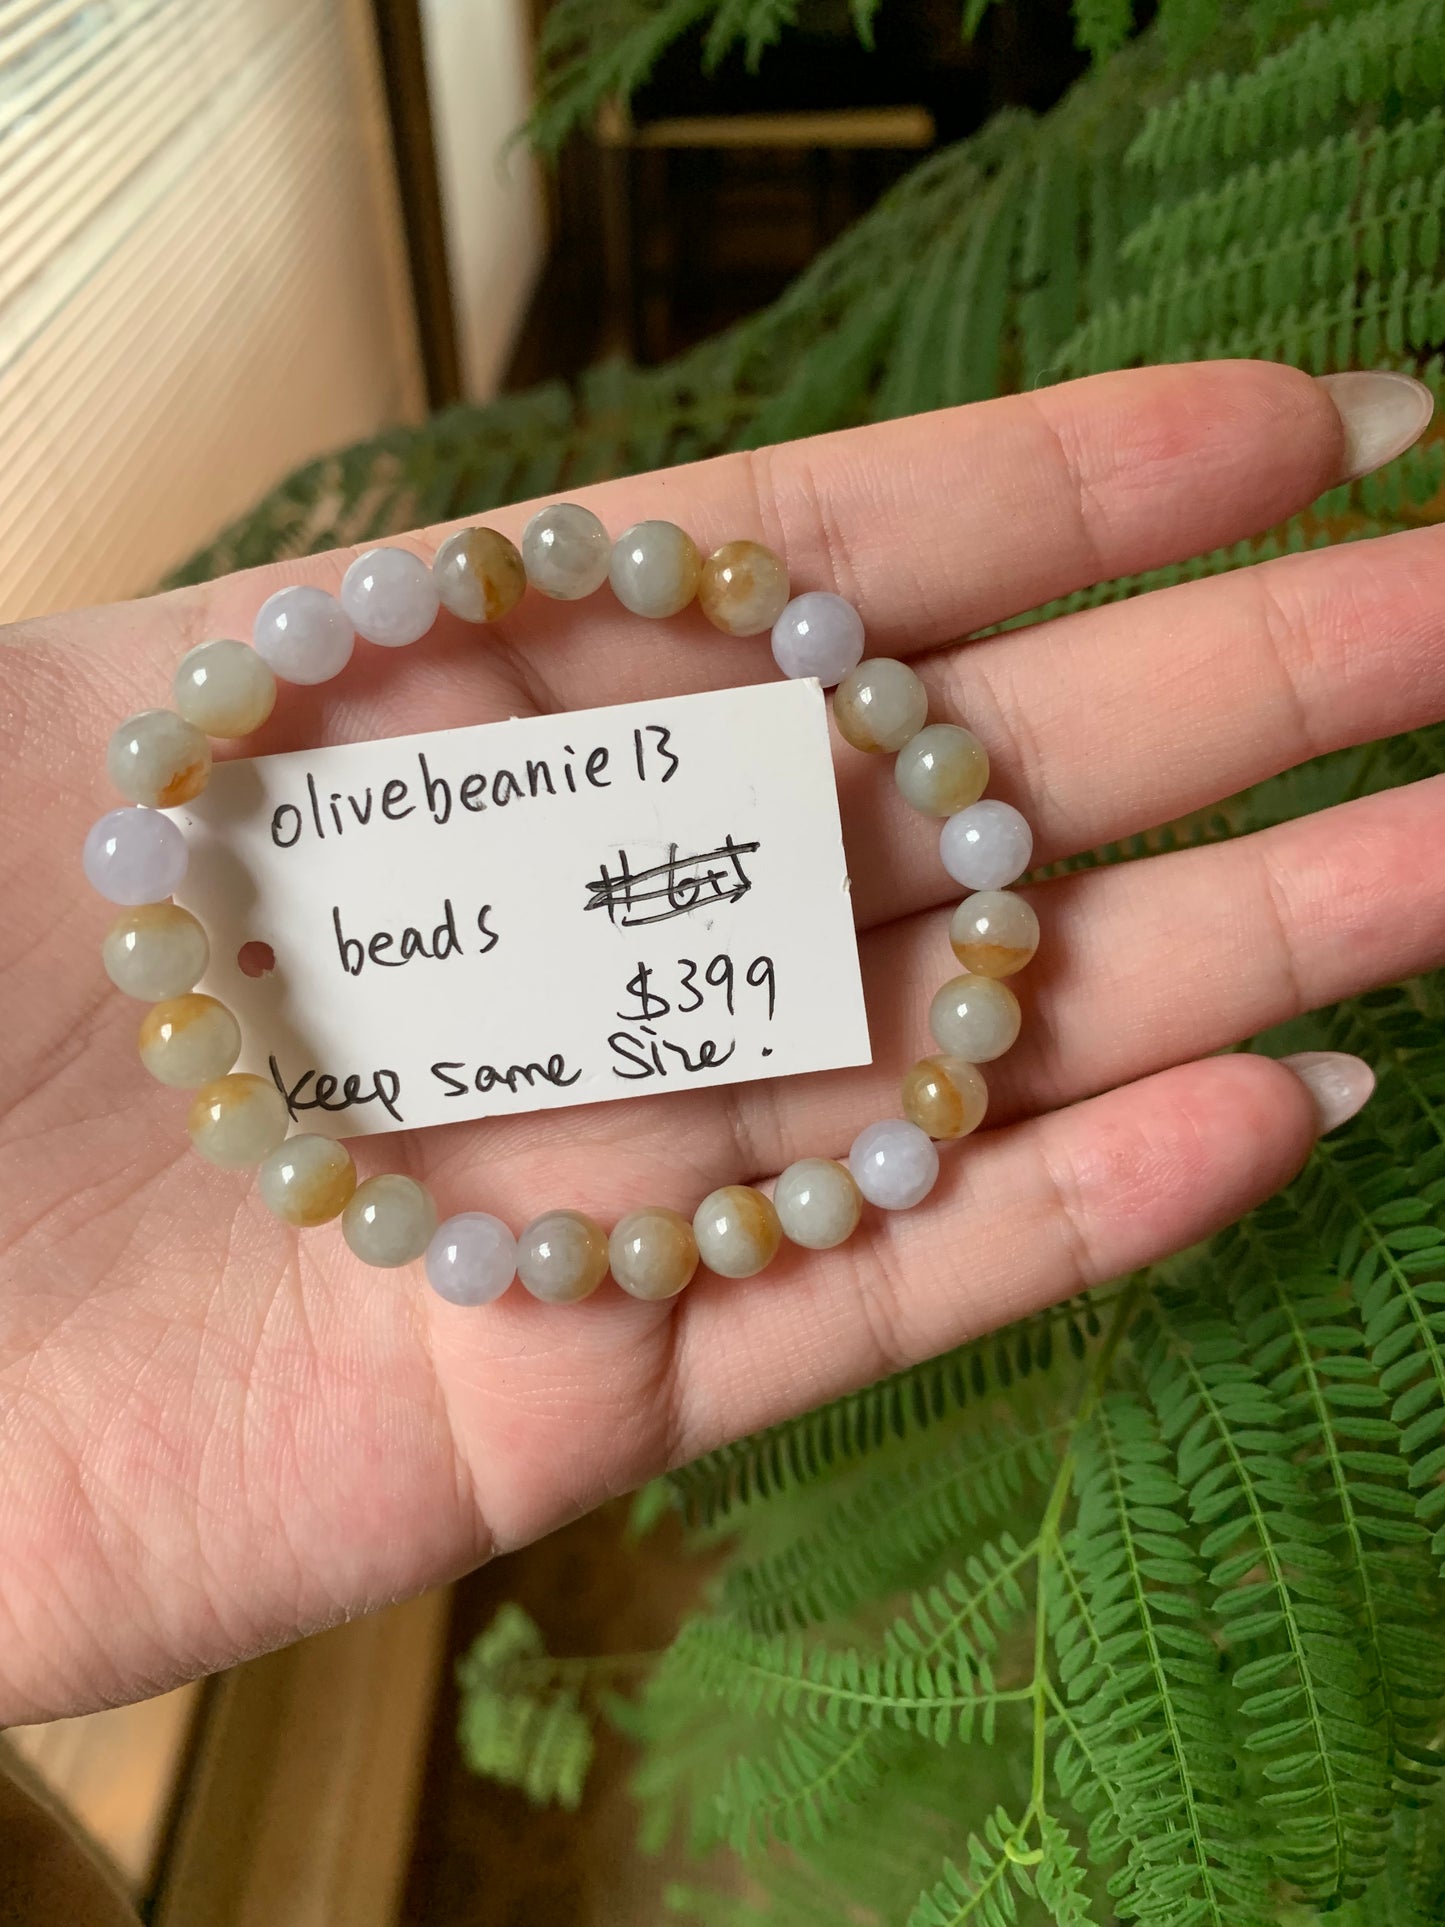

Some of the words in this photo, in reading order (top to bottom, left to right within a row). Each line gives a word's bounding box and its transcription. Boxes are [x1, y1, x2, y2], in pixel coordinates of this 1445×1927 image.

[333, 898, 498, 976] beads
[617, 954, 776, 1021] $399
[269, 1053, 404, 1122] keep
[431, 1053, 582, 1097] same
